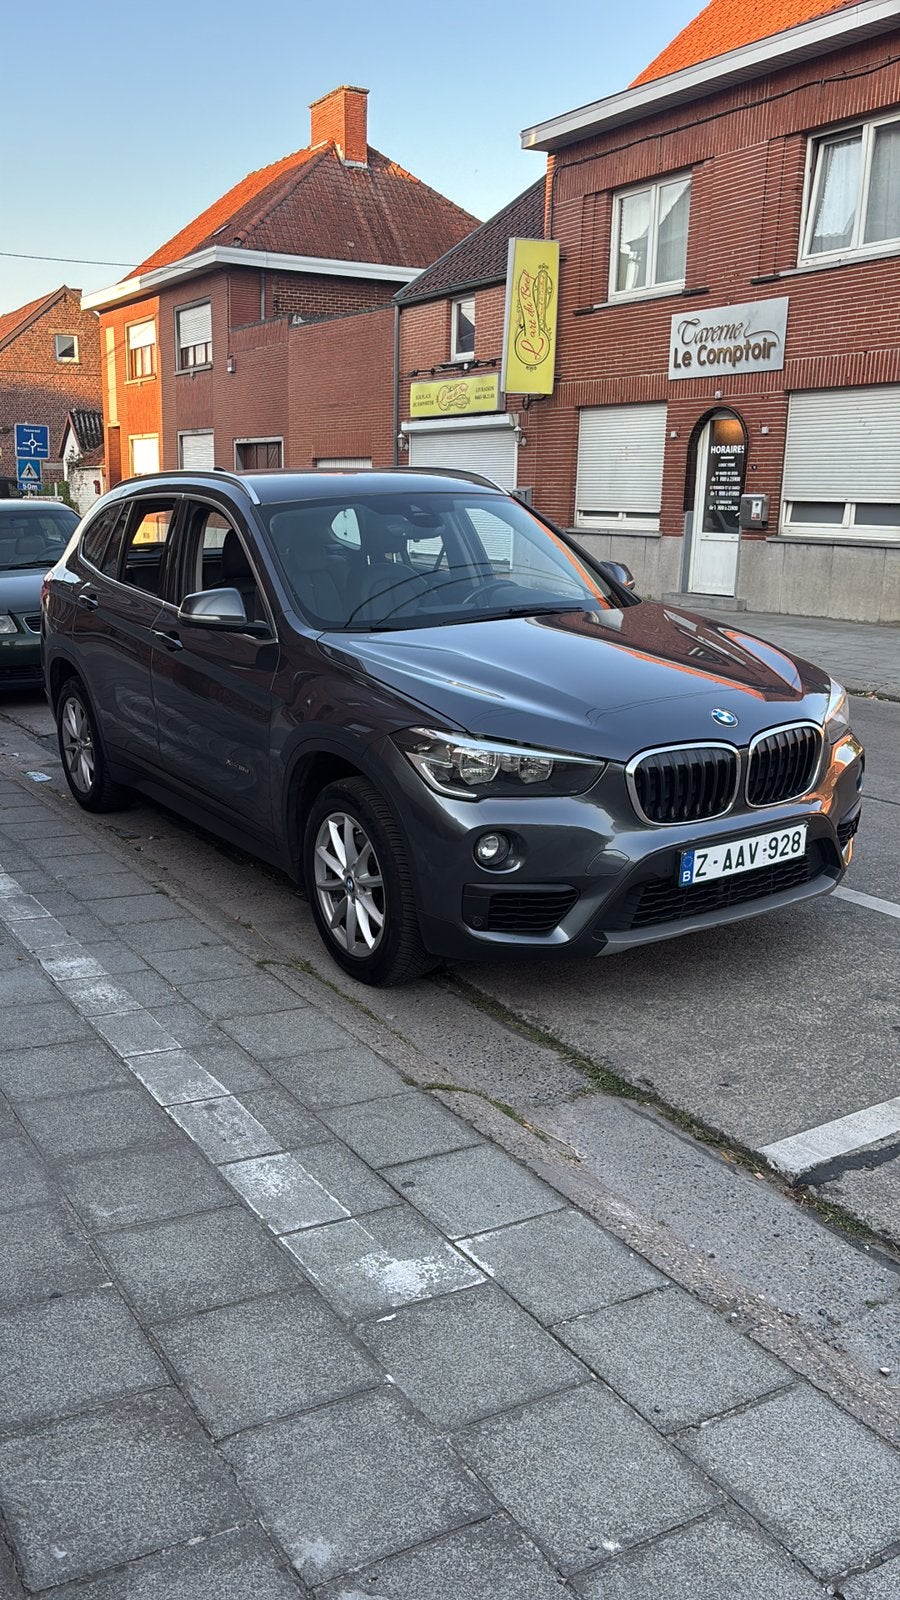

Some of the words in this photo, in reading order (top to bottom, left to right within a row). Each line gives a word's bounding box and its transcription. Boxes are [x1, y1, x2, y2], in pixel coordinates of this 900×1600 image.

[520, 269, 536, 300] Beef
[524, 301, 534, 320] du
[677, 318, 744, 345] Taverne
[673, 347, 692, 368] Le
[697, 338, 777, 368] Comptoir
[710, 445, 745, 454] HORAIRES
[682, 870, 691, 883] B
